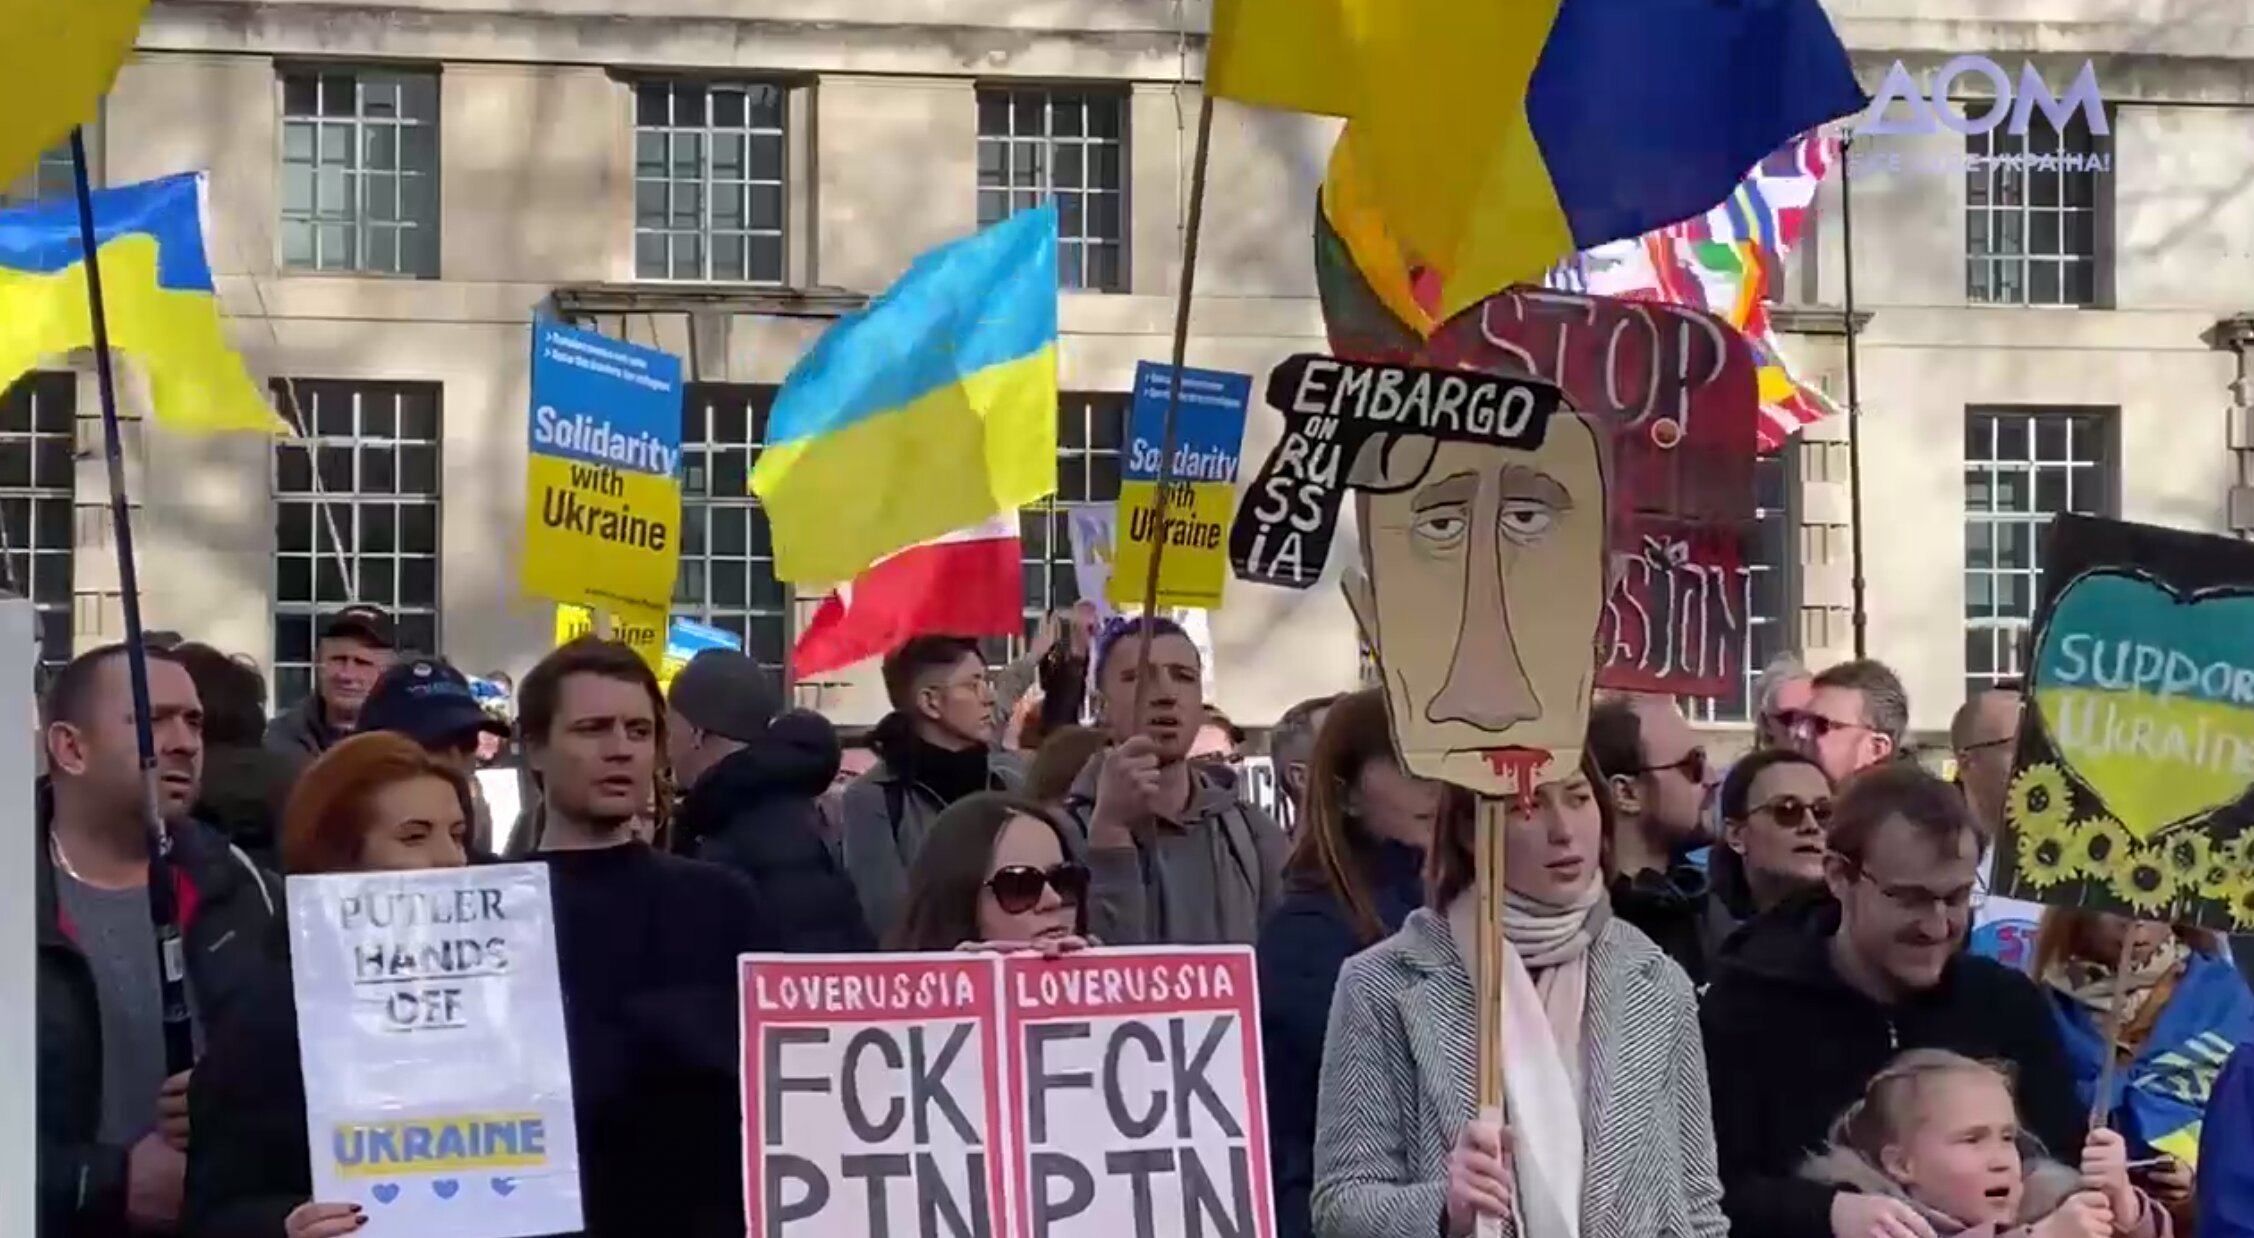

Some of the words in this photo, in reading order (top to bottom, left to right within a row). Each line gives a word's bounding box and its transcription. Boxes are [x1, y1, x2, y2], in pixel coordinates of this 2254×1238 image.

[1481, 290, 1726, 437] STOP
[1293, 360, 1534, 437] EMBARGO
[535, 405, 678, 477] Solidarity
[1304, 415, 1339, 440] ON
[571, 464, 623, 497] with
[1130, 437, 1237, 481] Sodarity
[1160, 481, 1195, 508] ith
[543, 486, 666, 550] Ukraine
[340, 888, 506, 930] PUTLER
[353, 937, 509, 978] HANDS
[386, 988, 463, 1025] OFF
[756, 971, 975, 1011] LOVERUSSIA
[1017, 964, 1234, 1008] LOVERUSSIA
[764, 1022, 984, 1146] FCK
[1025, 1015, 1244, 1144] FCK
[332, 1119, 546, 1165] UKRAINE
[765, 1152, 992, 1238] PTN
[1031, 1146, 1255, 1238] PTN
